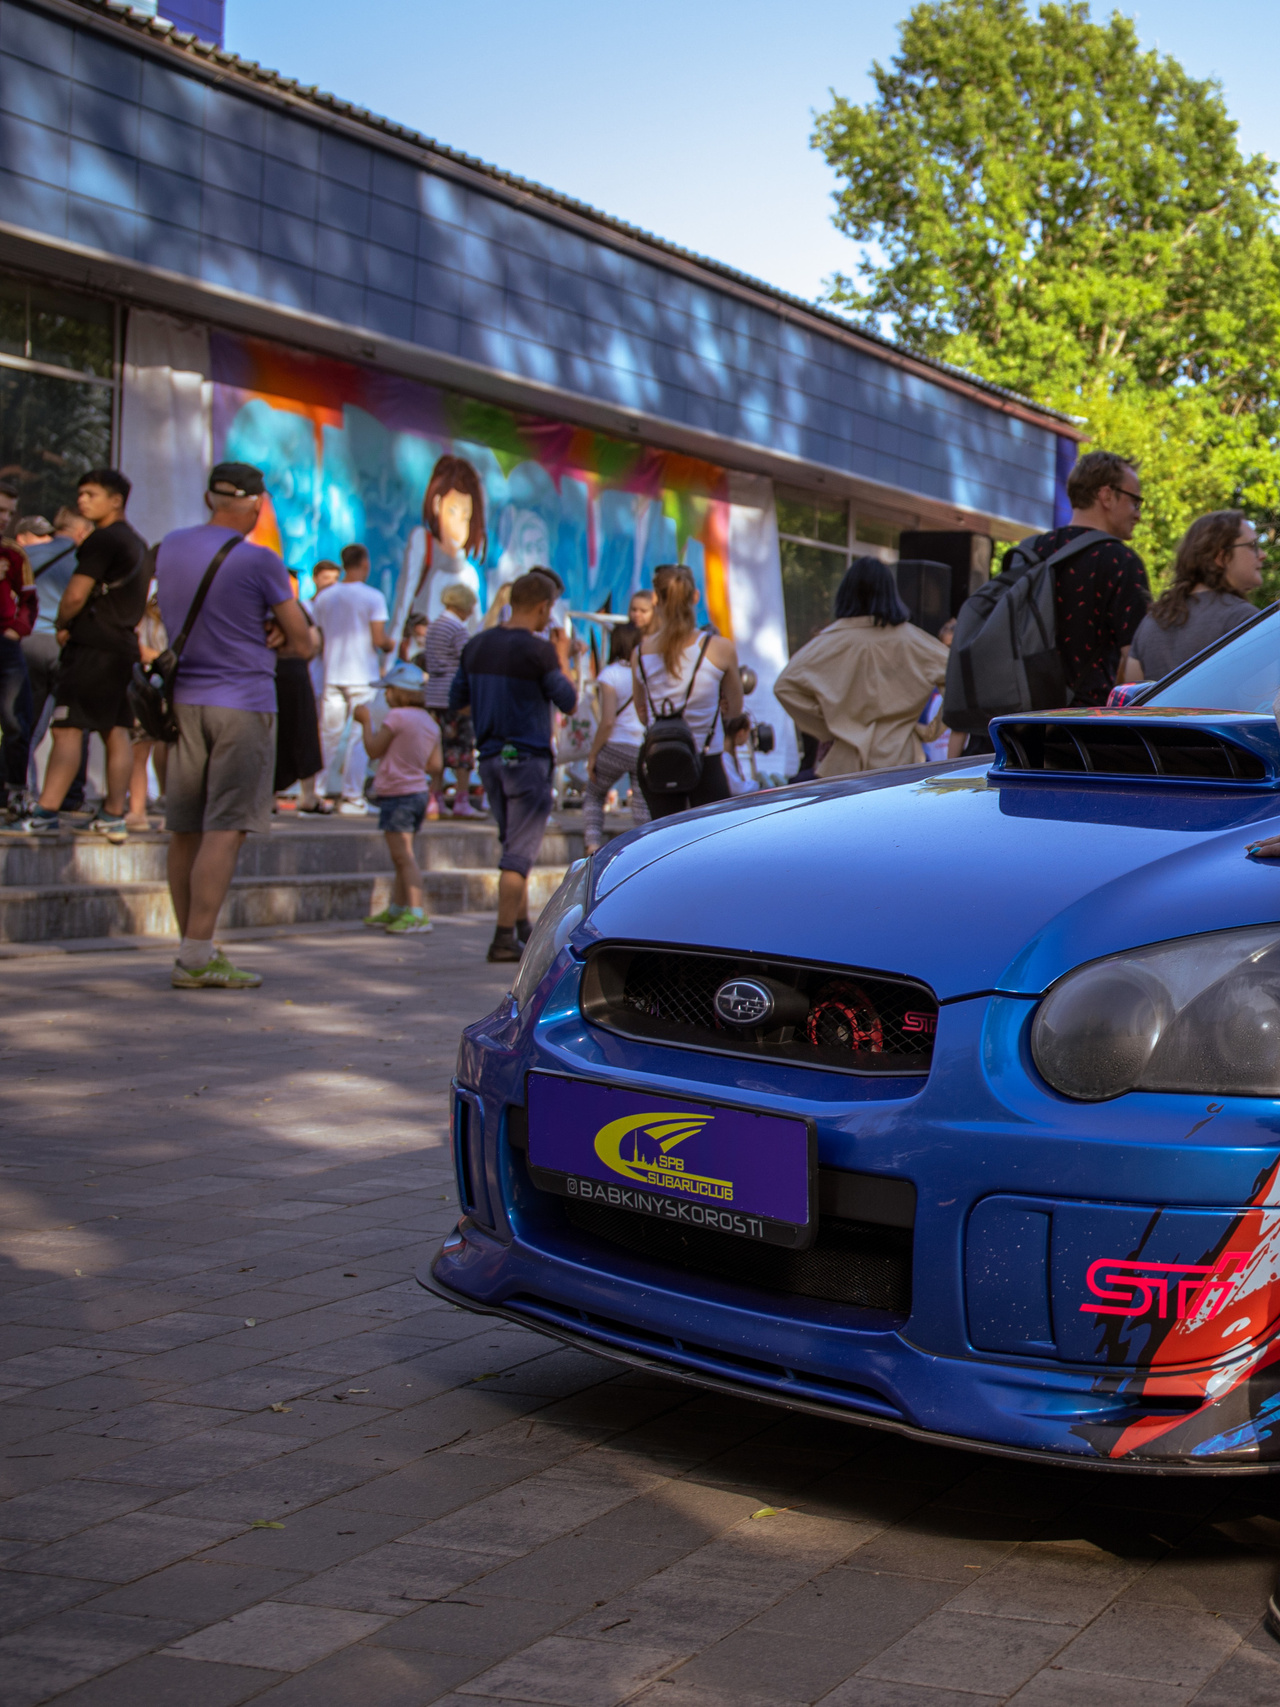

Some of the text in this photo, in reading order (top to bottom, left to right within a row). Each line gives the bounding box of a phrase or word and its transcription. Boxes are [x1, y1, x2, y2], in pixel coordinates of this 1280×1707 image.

[658, 1154, 685, 1171] SPB
[646, 1171, 734, 1201] SUBARUCLUB
[580, 1180, 764, 1238] BABKINYSKOROSTI
[1078, 1251, 1254, 1320] STI
